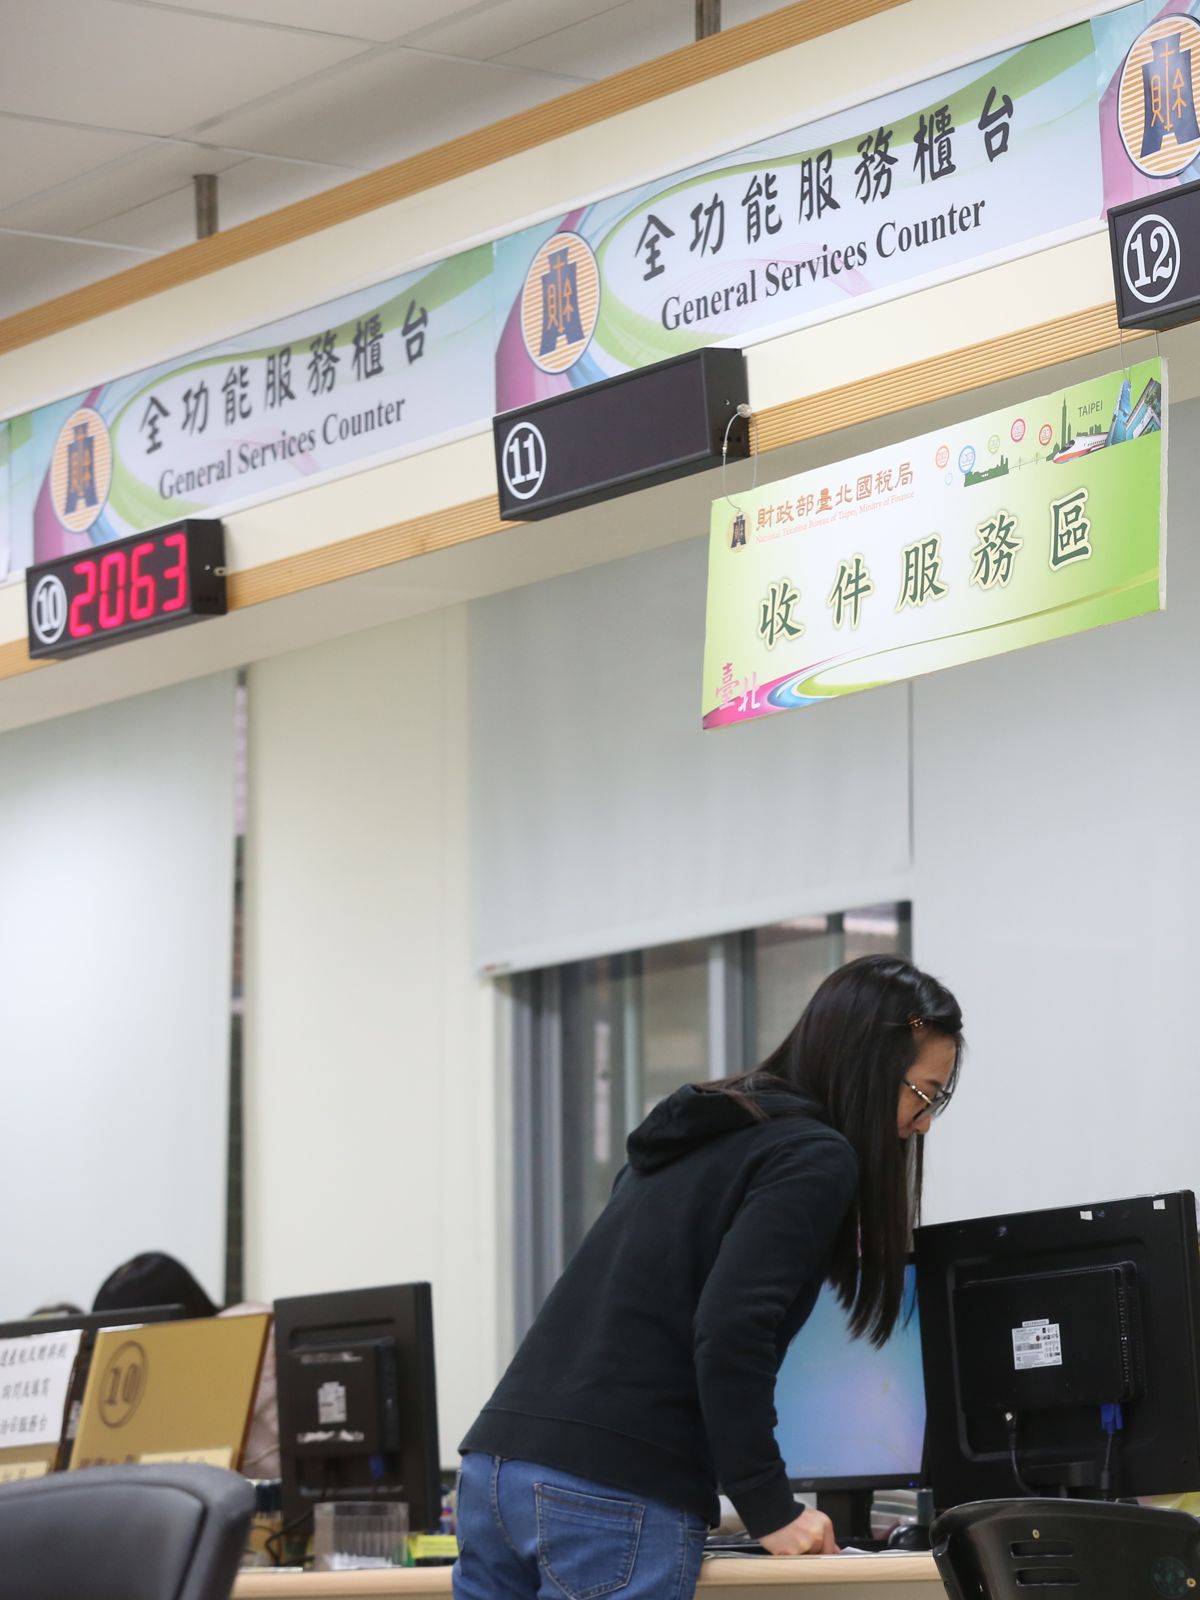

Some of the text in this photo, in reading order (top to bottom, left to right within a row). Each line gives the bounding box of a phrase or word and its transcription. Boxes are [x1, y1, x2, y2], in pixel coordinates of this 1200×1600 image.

[634, 86, 1014, 281] 全功能服務櫃台
[661, 200, 986, 331] General Services Counter
[1133, 228, 1173, 288] 12
[139, 300, 430, 455] 全功能服務櫃台
[1078, 400, 1103, 418] TAIPEI
[159, 396, 406, 500] General Services Counter
[756, 462, 914, 530] 財政部臺北國稅局
[68, 533, 189, 638] 2063
[760, 490, 1090, 647] 收件服務區
